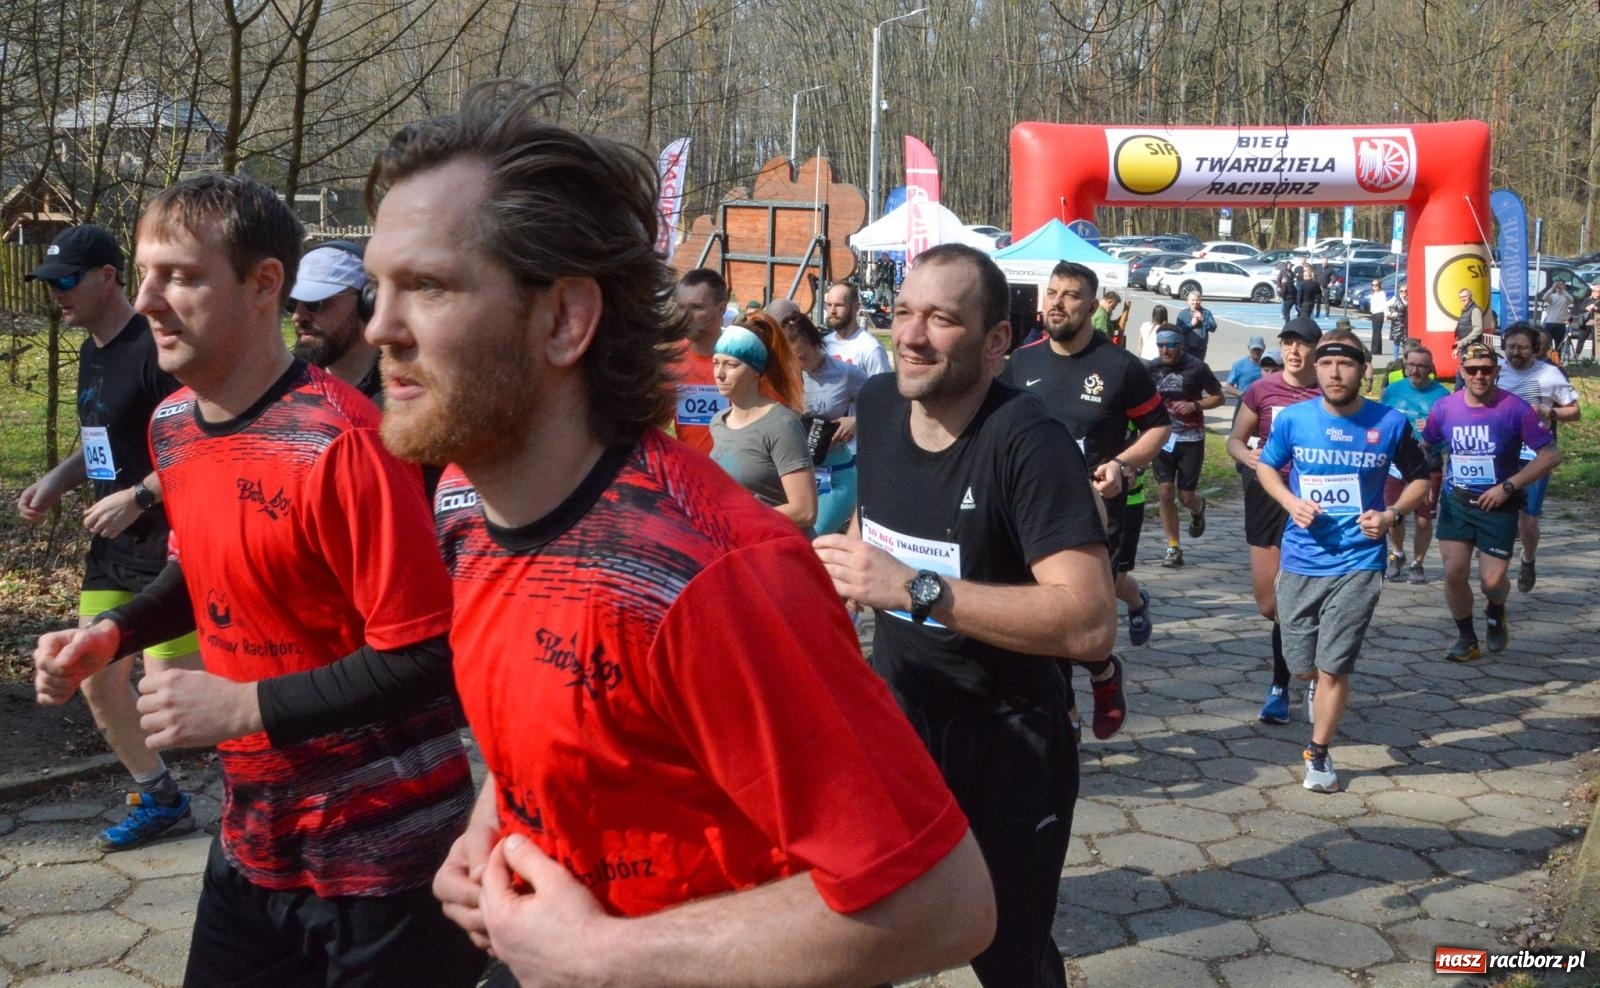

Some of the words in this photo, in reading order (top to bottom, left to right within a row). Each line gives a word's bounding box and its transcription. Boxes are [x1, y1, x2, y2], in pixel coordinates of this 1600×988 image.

[1237, 135, 1289, 149] BIEG
[1195, 157, 1336, 172] TWARDZIELA
[1206, 177, 1321, 195] RACIBÓRZ
[685, 399, 719, 414] 024
[1451, 425, 1490, 451] RUN
[87, 446, 106, 465] 045
[1293, 446, 1388, 467] RUNNERS
[1460, 466, 1485, 477] 091
[1310, 489, 1350, 504] 040
[896, 540, 950, 558] TWARDZIELA
